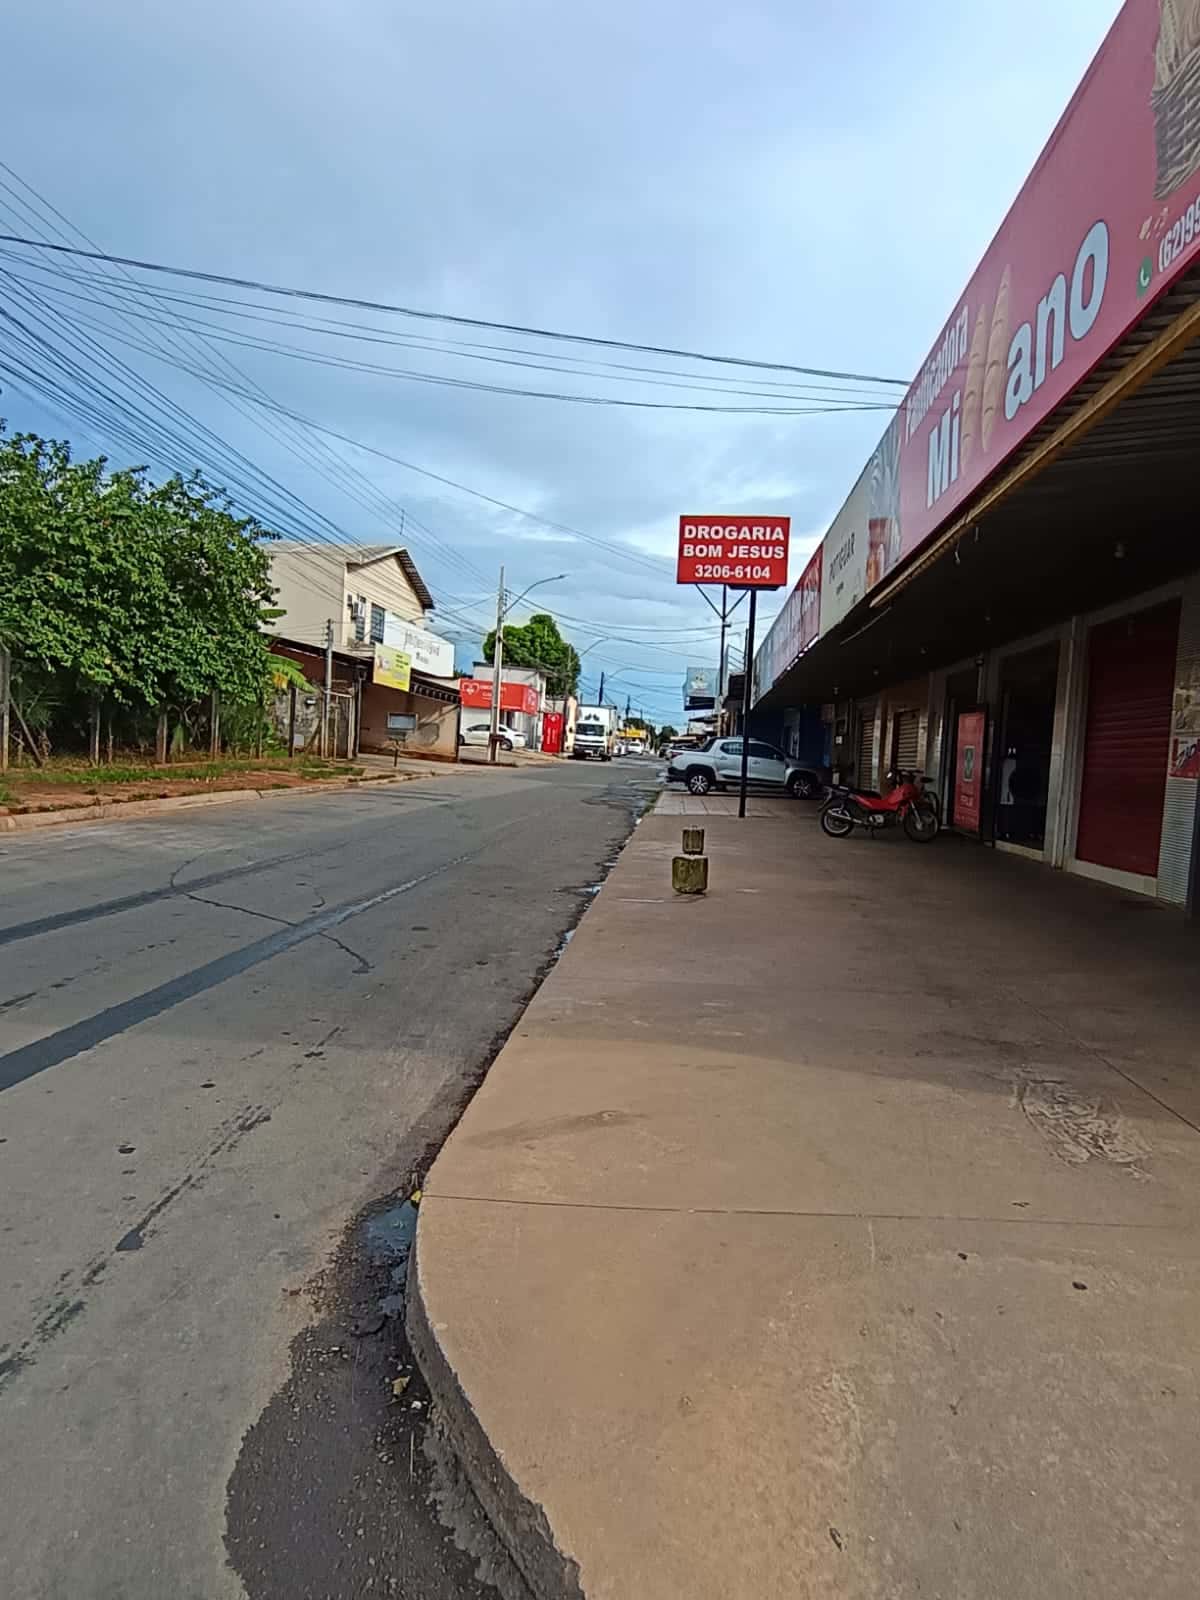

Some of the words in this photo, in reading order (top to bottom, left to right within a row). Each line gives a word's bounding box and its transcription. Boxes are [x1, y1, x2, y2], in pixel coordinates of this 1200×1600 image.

[684, 525, 784, 540] DROGARIA
[683, 544, 722, 558] BOM
[727, 545, 785, 559] JESUS
[695, 564, 770, 579] 3206-6104
